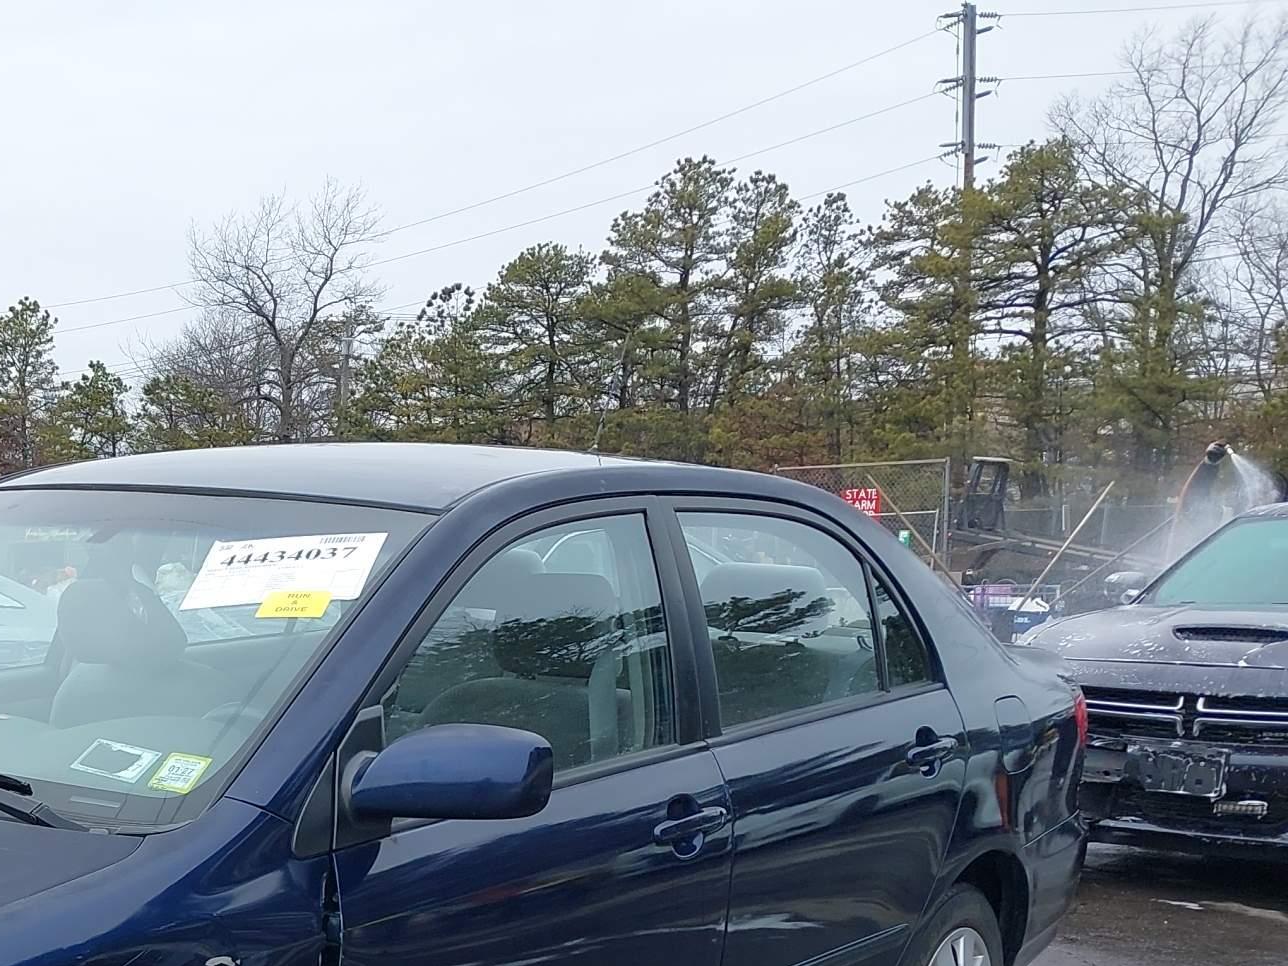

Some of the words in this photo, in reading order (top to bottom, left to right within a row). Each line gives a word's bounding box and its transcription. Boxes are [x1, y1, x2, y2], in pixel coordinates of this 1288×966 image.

[846, 488, 878, 500] STATE
[847, 500, 876, 510] ARM
[221, 546, 358, 567] 44434037
